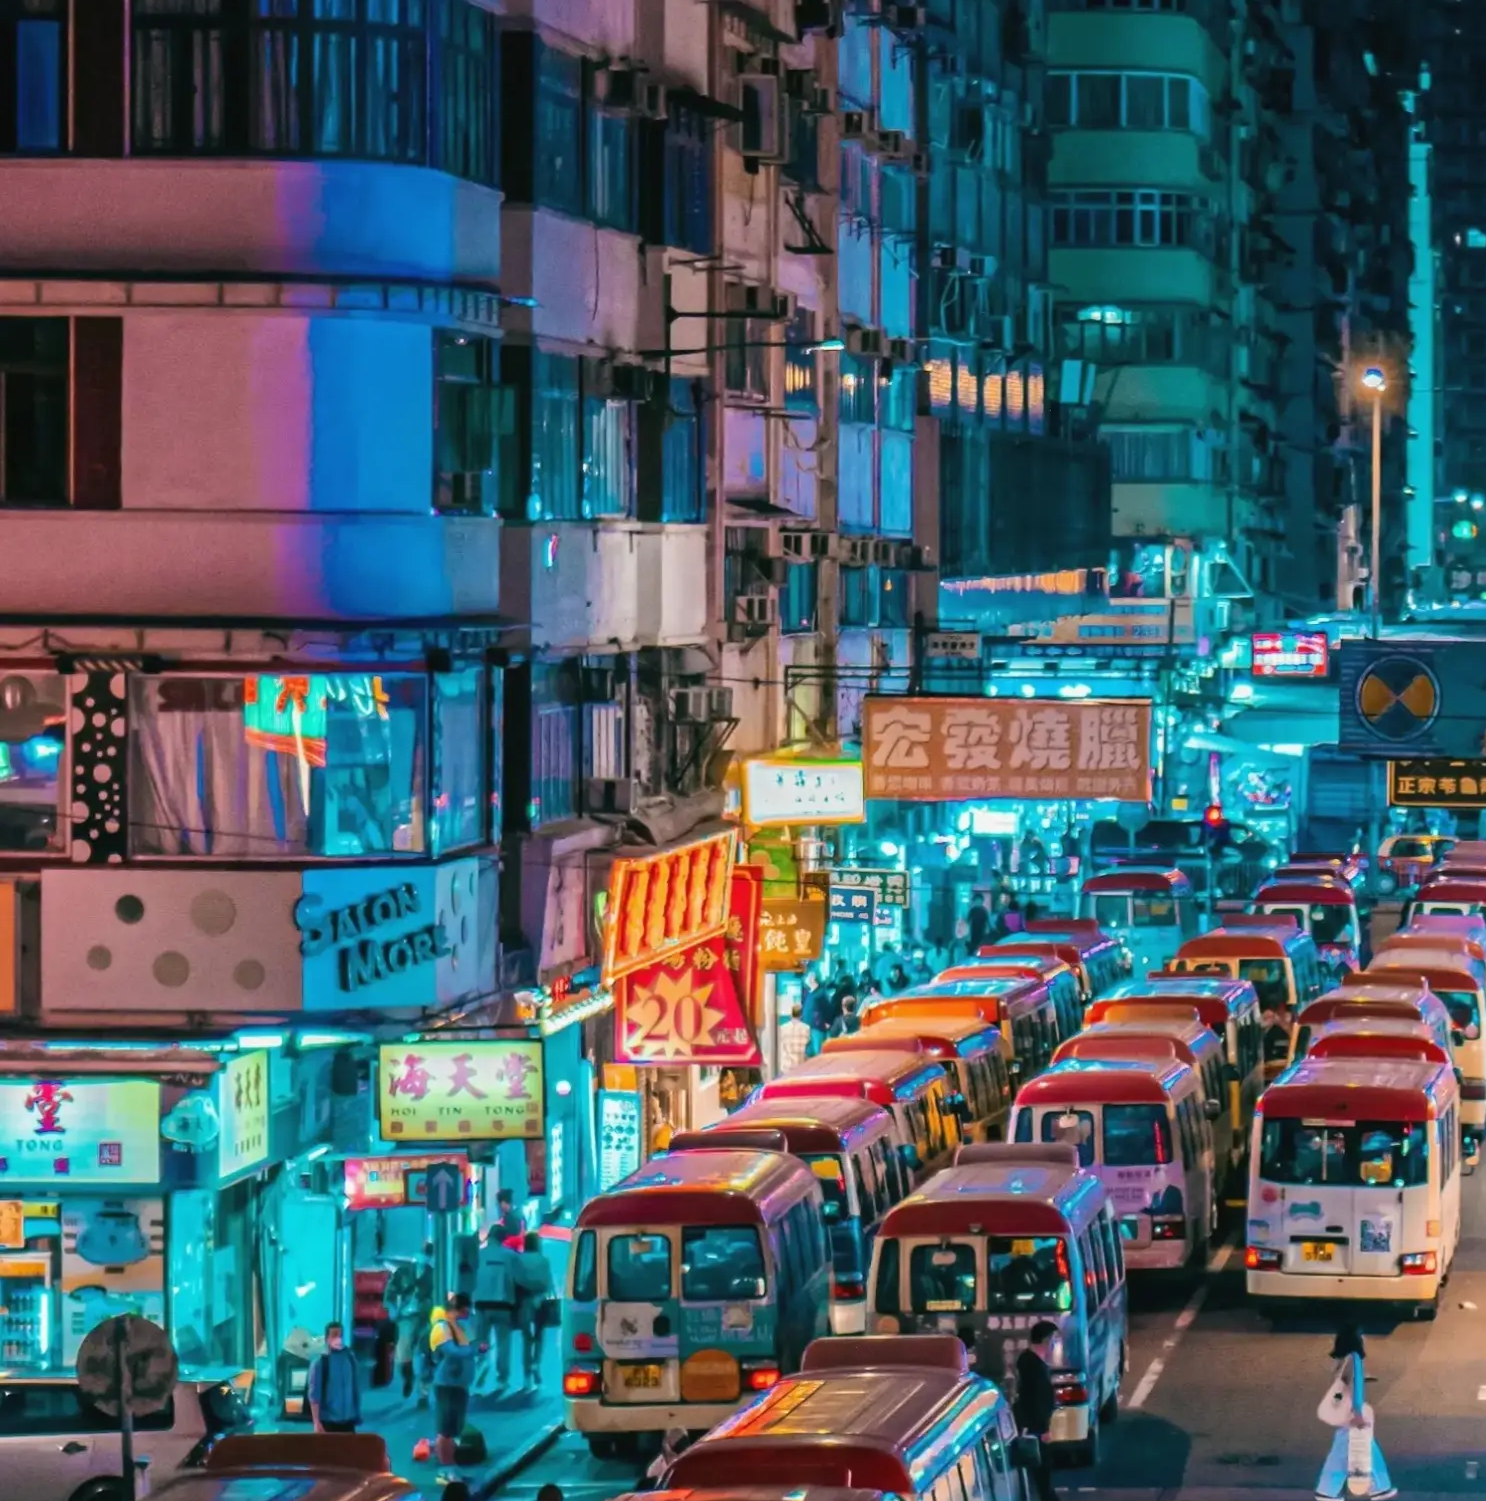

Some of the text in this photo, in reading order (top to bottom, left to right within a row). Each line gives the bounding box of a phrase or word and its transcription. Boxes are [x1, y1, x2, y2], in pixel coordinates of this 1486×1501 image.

[294, 883, 422, 957] SALON
[338, 924, 452, 993] MORE
[641, 994, 703, 1044] 20
[388, 1052, 539, 1102] 海天堂
[438, 1107, 463, 1116] TIN
[485, 1106, 525, 1116] TONG
[17, 1139, 64, 1152] TONG
